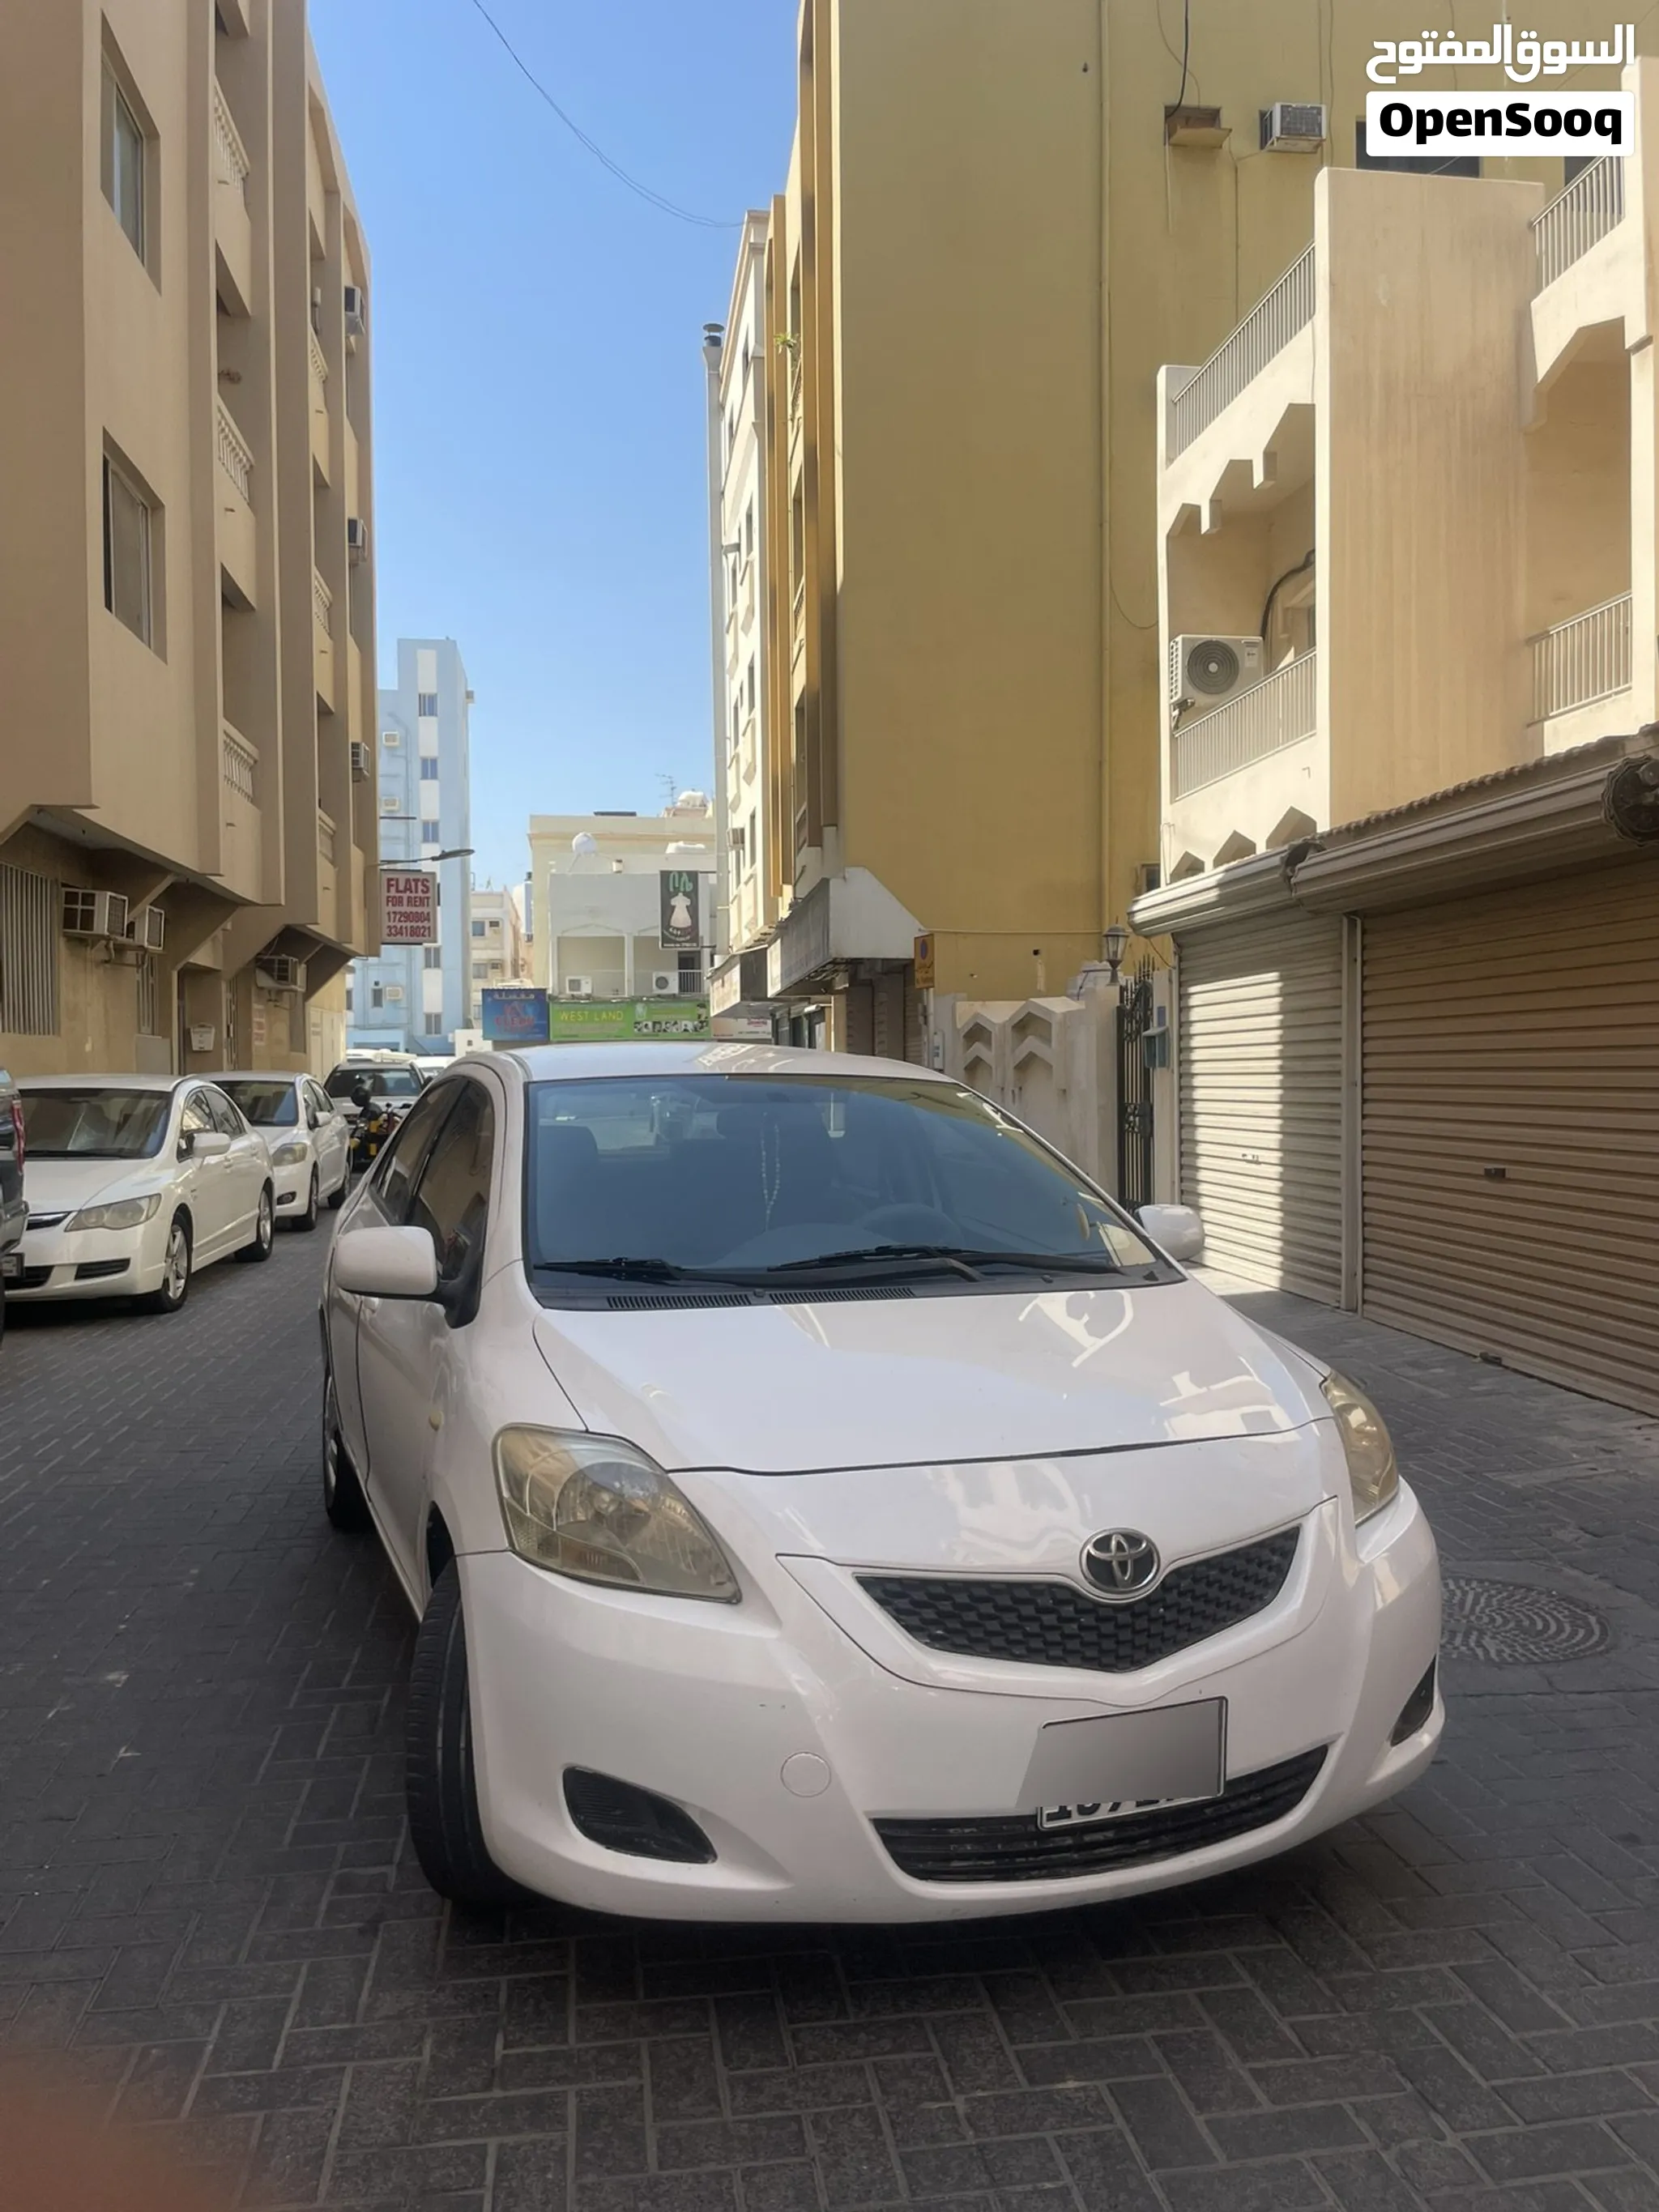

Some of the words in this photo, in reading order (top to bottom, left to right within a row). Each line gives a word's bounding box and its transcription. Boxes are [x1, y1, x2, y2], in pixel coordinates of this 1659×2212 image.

[386, 877, 430, 894] FLATS
[386, 896, 403, 907] FOR
[407, 896, 431, 907] RENT
[386, 911, 431, 923] 17290804
[386, 925, 431, 937] 33418021
[560, 1010, 589, 1021] WEST
[594, 1010, 623, 1021] LAND
